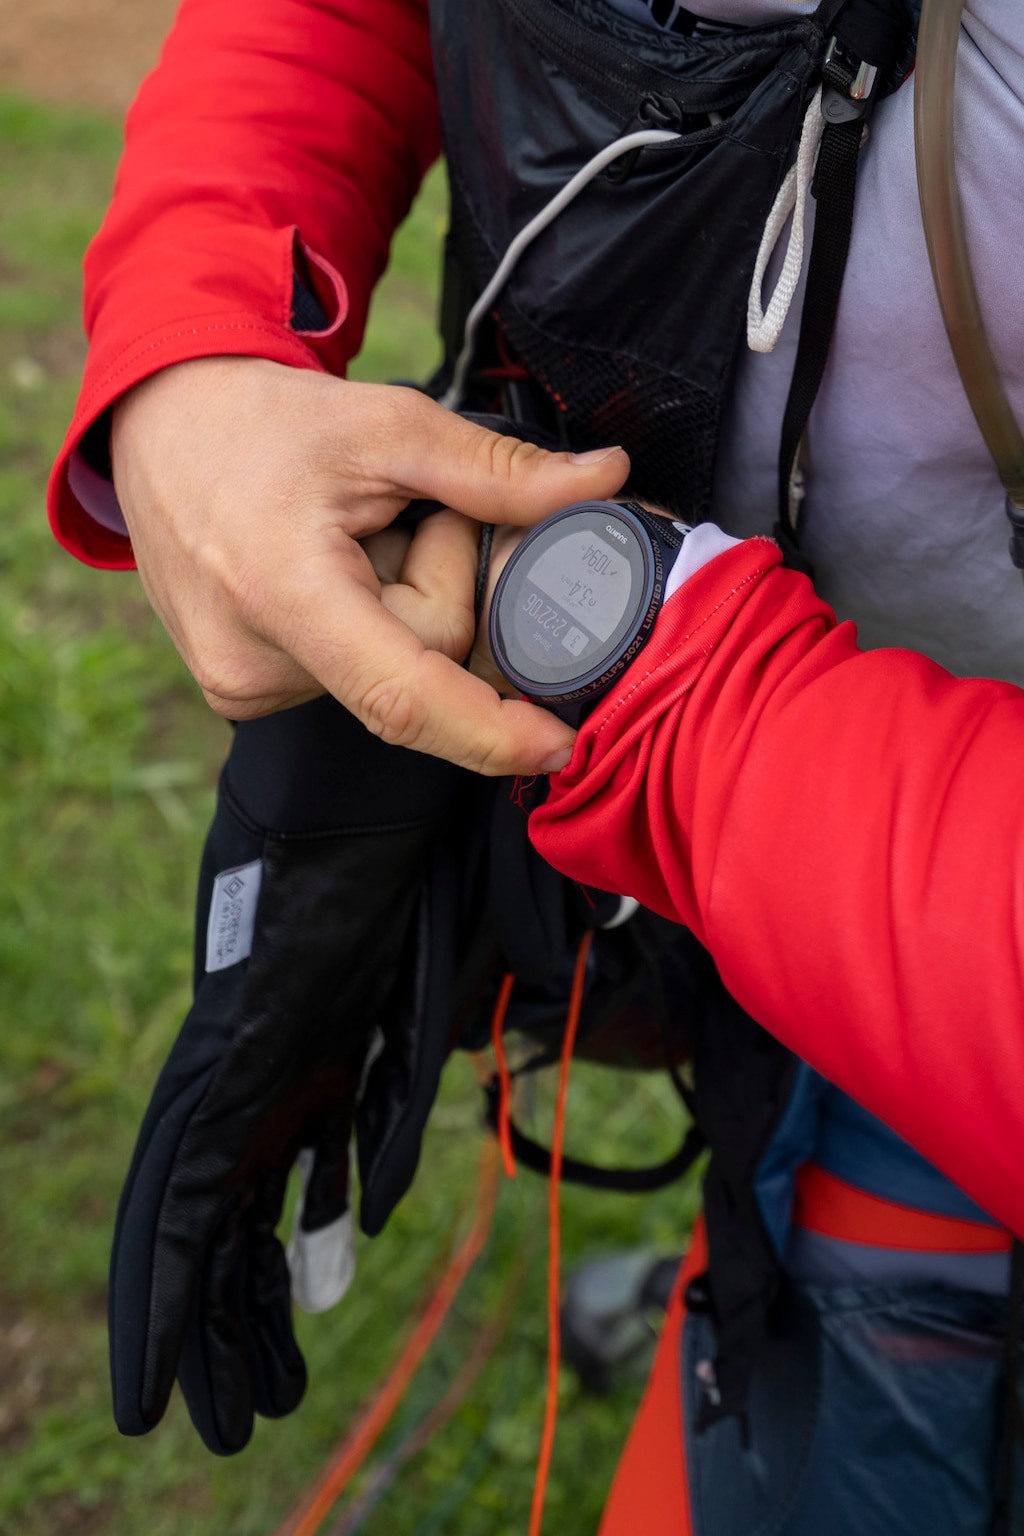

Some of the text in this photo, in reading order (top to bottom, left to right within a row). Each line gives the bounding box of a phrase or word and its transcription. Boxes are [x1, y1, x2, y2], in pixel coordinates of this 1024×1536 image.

[605, 524, 629, 545] SUUNTO
[582, 544, 612, 576] 1094
[542, 538, 663, 703] RED BULL X-ALPS 2021 LIMITED EDITION
